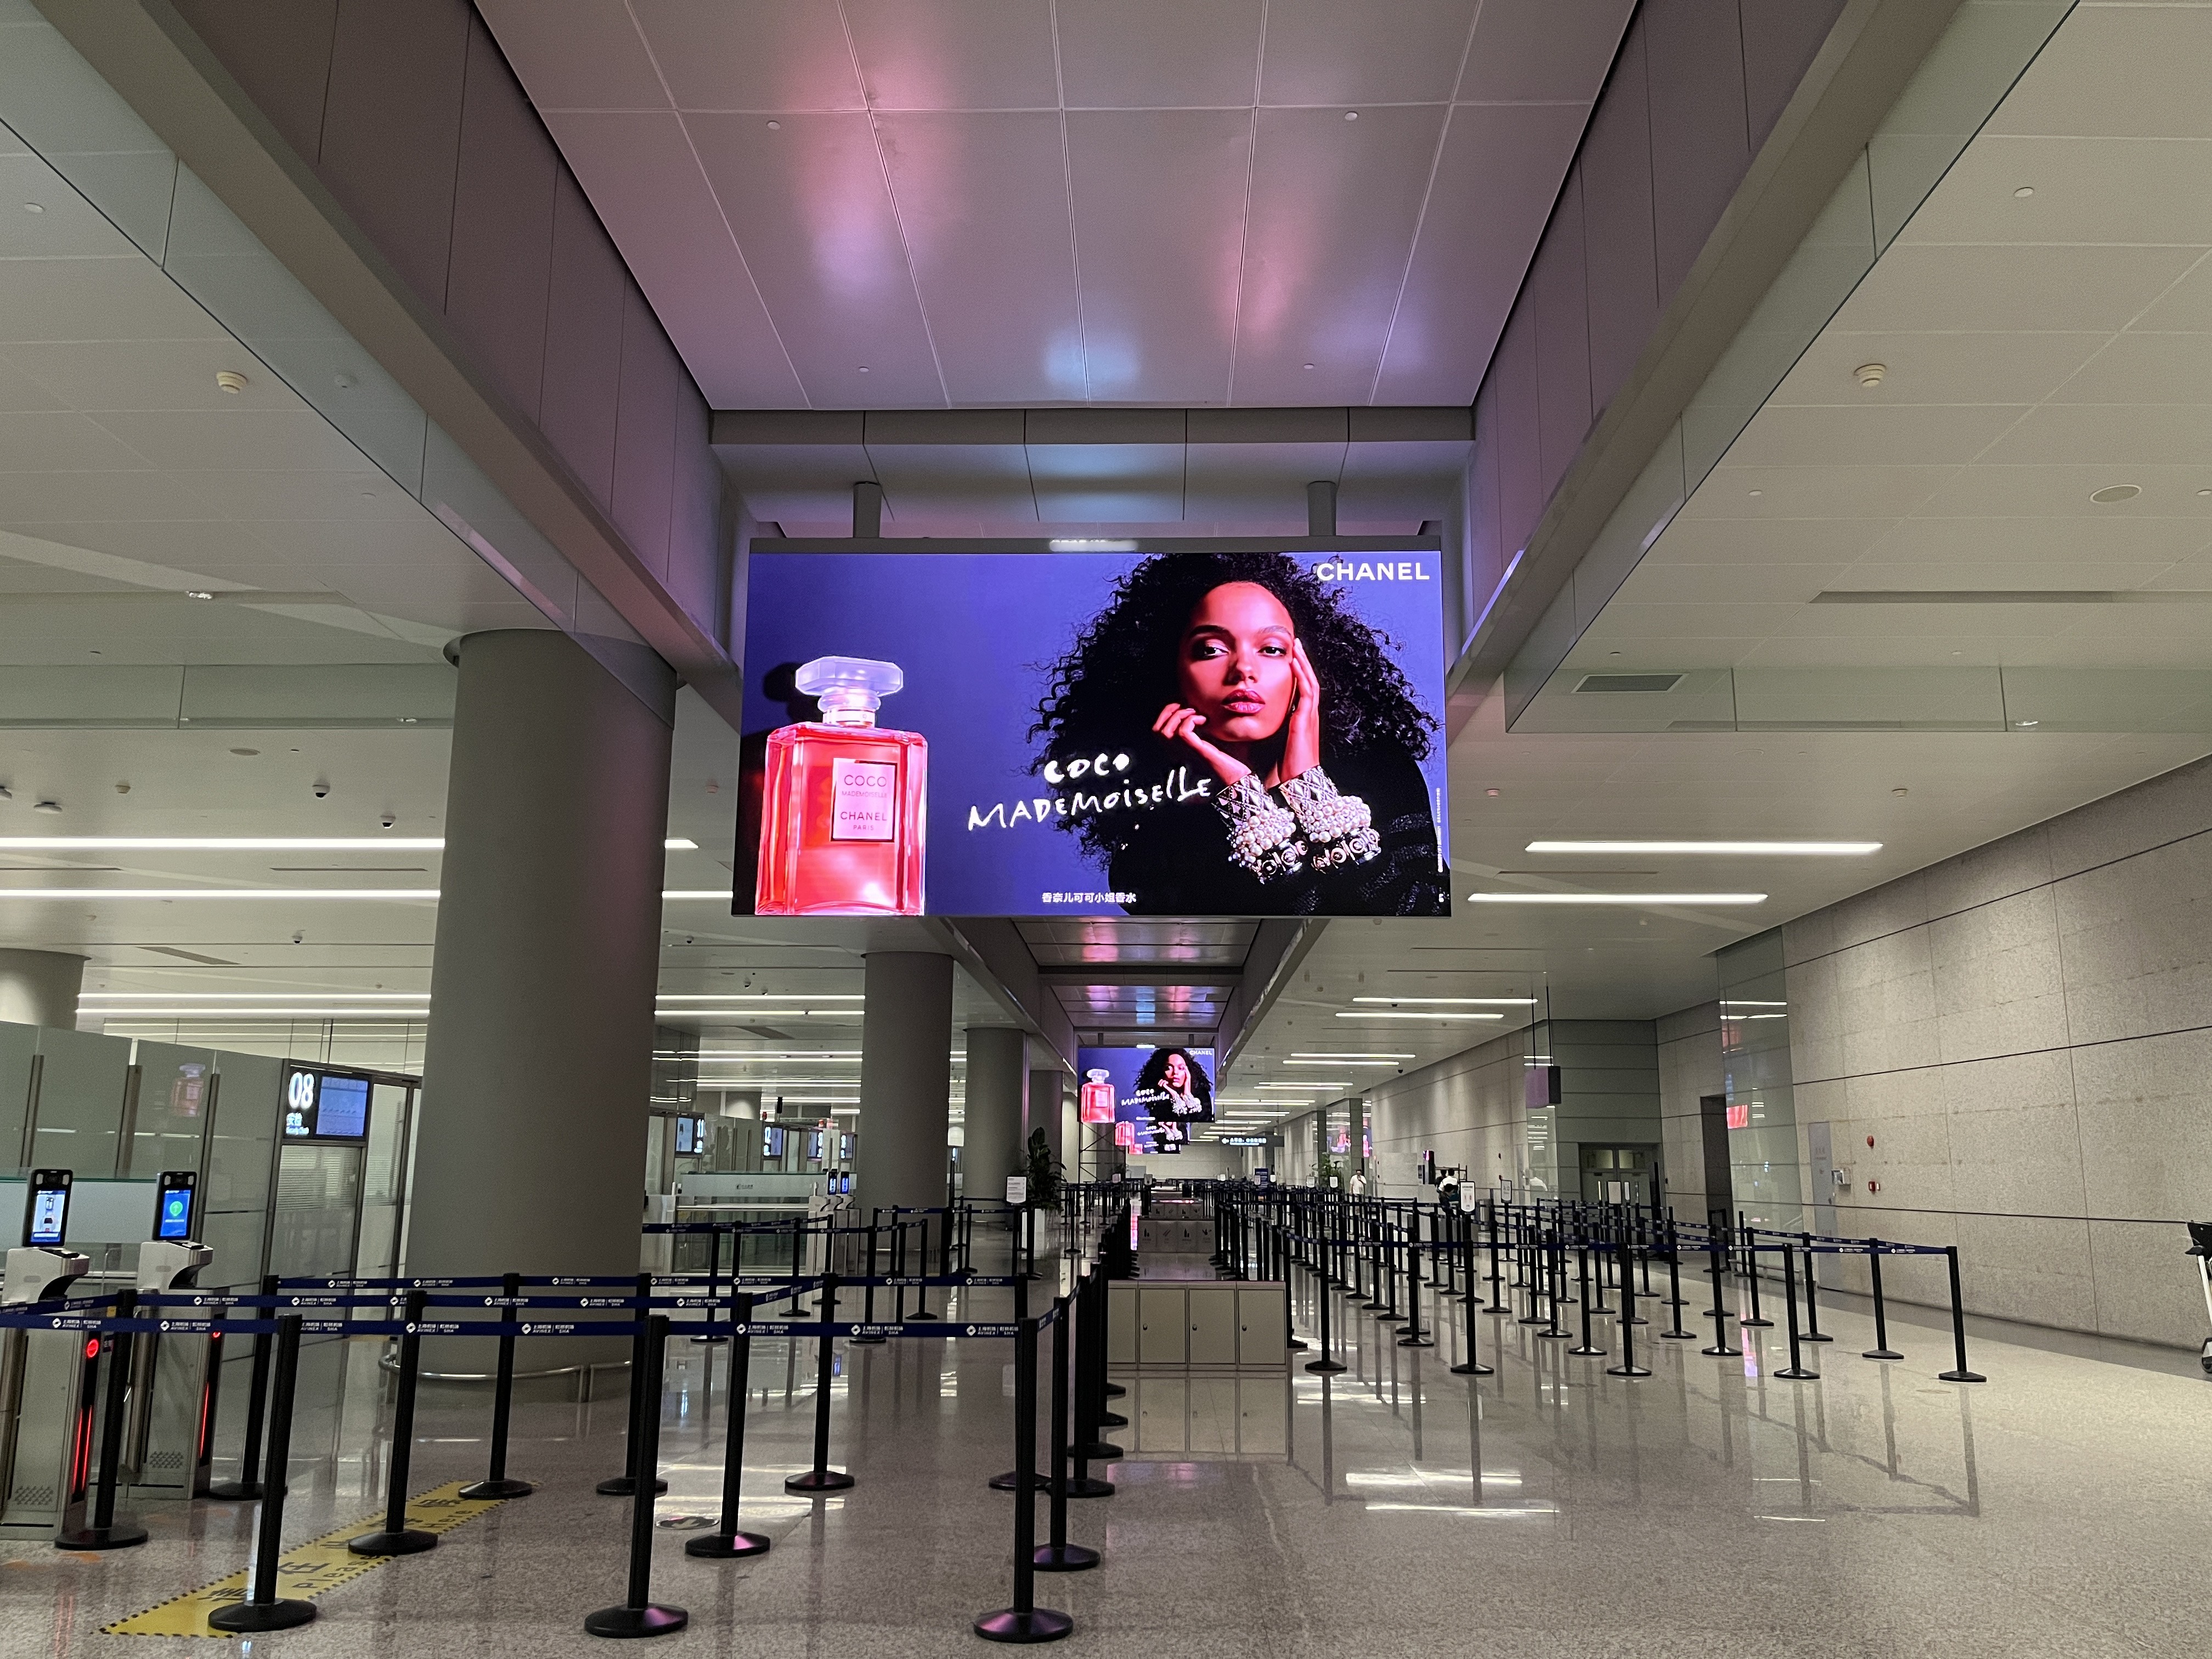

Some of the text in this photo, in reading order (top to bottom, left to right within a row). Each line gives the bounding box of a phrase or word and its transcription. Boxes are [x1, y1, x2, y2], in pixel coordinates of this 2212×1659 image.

[1317, 562, 1430, 581] CHANEL
[844, 775, 887, 787] COCO
[840, 811, 888, 821] CHANEL
[1042, 892, 1137, 904] 香奈儿可可小姐香水
[288, 1072, 315, 1109] 08
